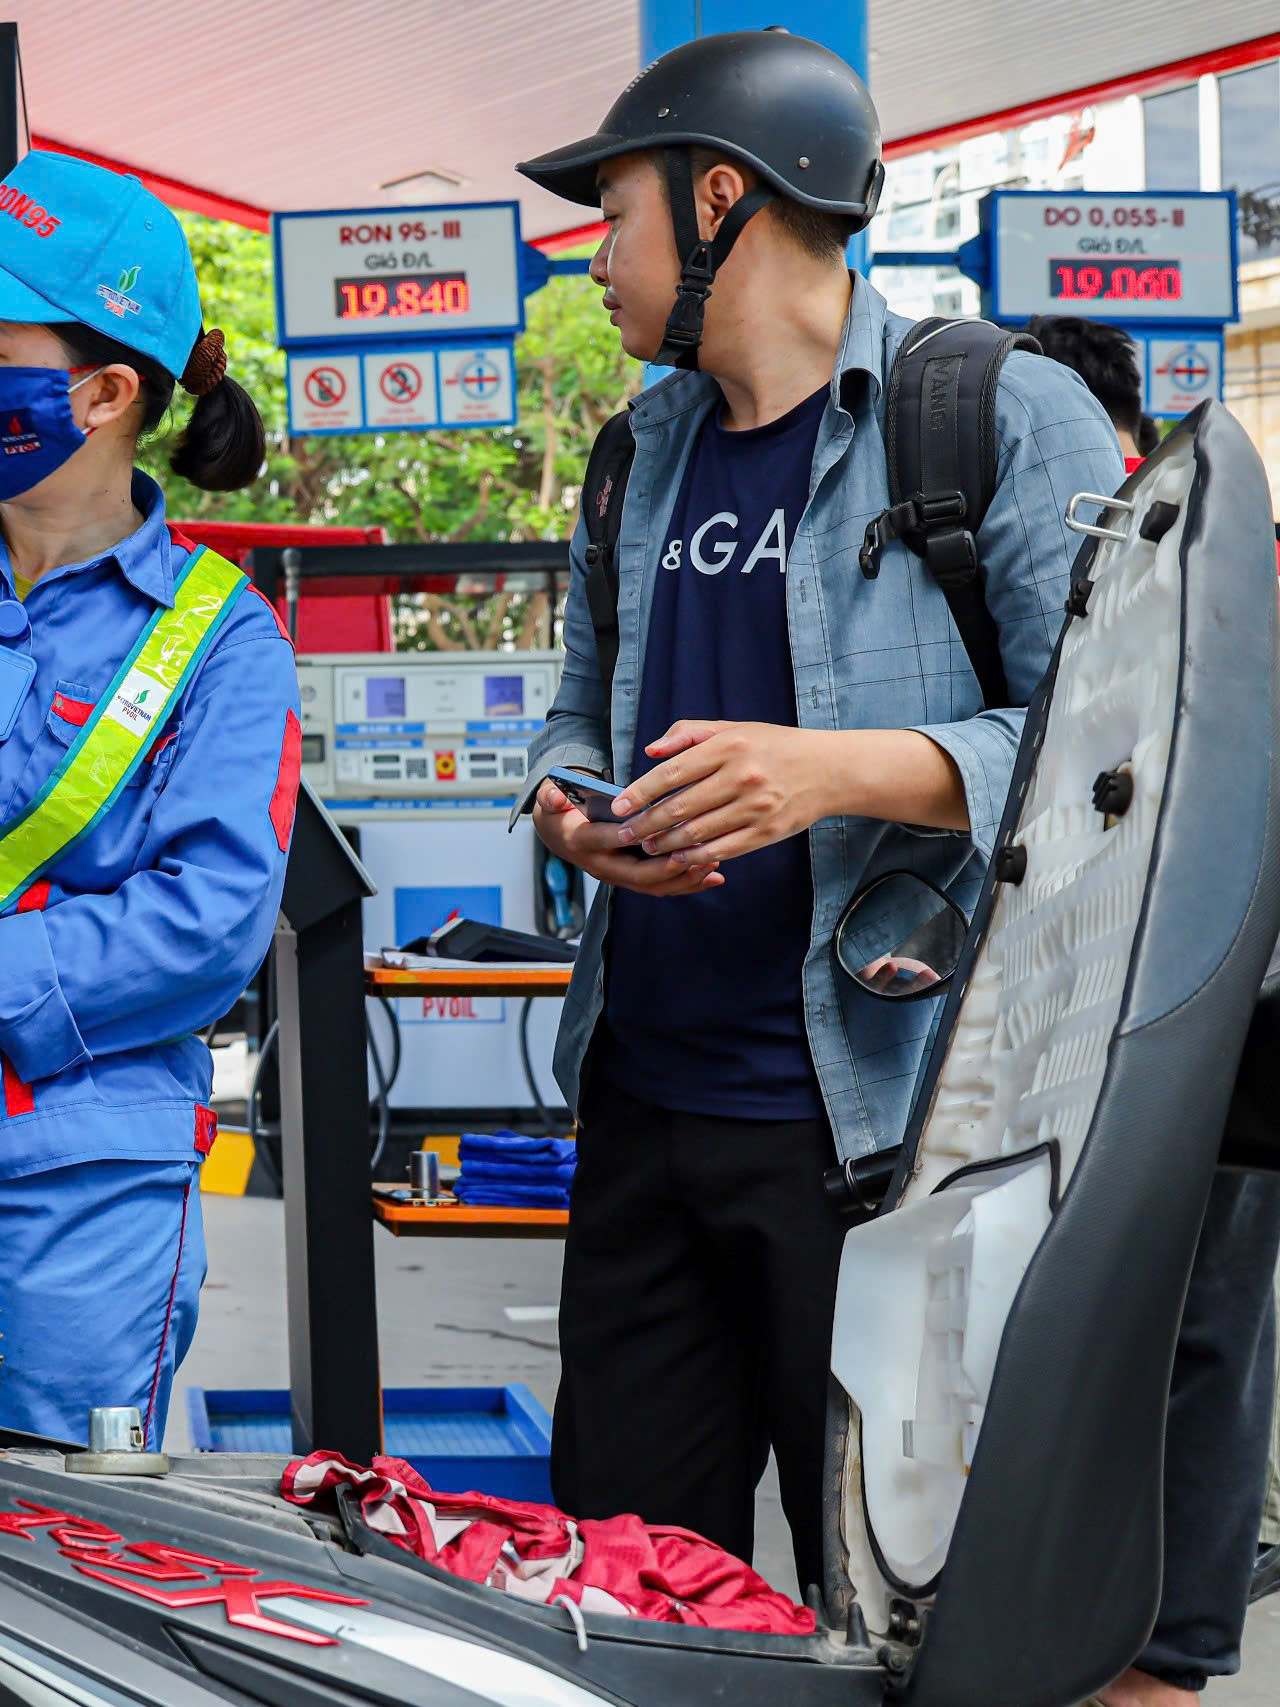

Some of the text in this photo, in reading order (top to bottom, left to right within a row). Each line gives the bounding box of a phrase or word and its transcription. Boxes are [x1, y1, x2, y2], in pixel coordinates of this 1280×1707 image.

[1044, 207, 1081, 227] DO
[339, 225, 392, 245] RON
[364, 252, 398, 270] Giá
[1056, 266, 1183, 300] 19.060
[341, 279, 470, 320] 19.840
[423, 996, 477, 1019] PVOIL
